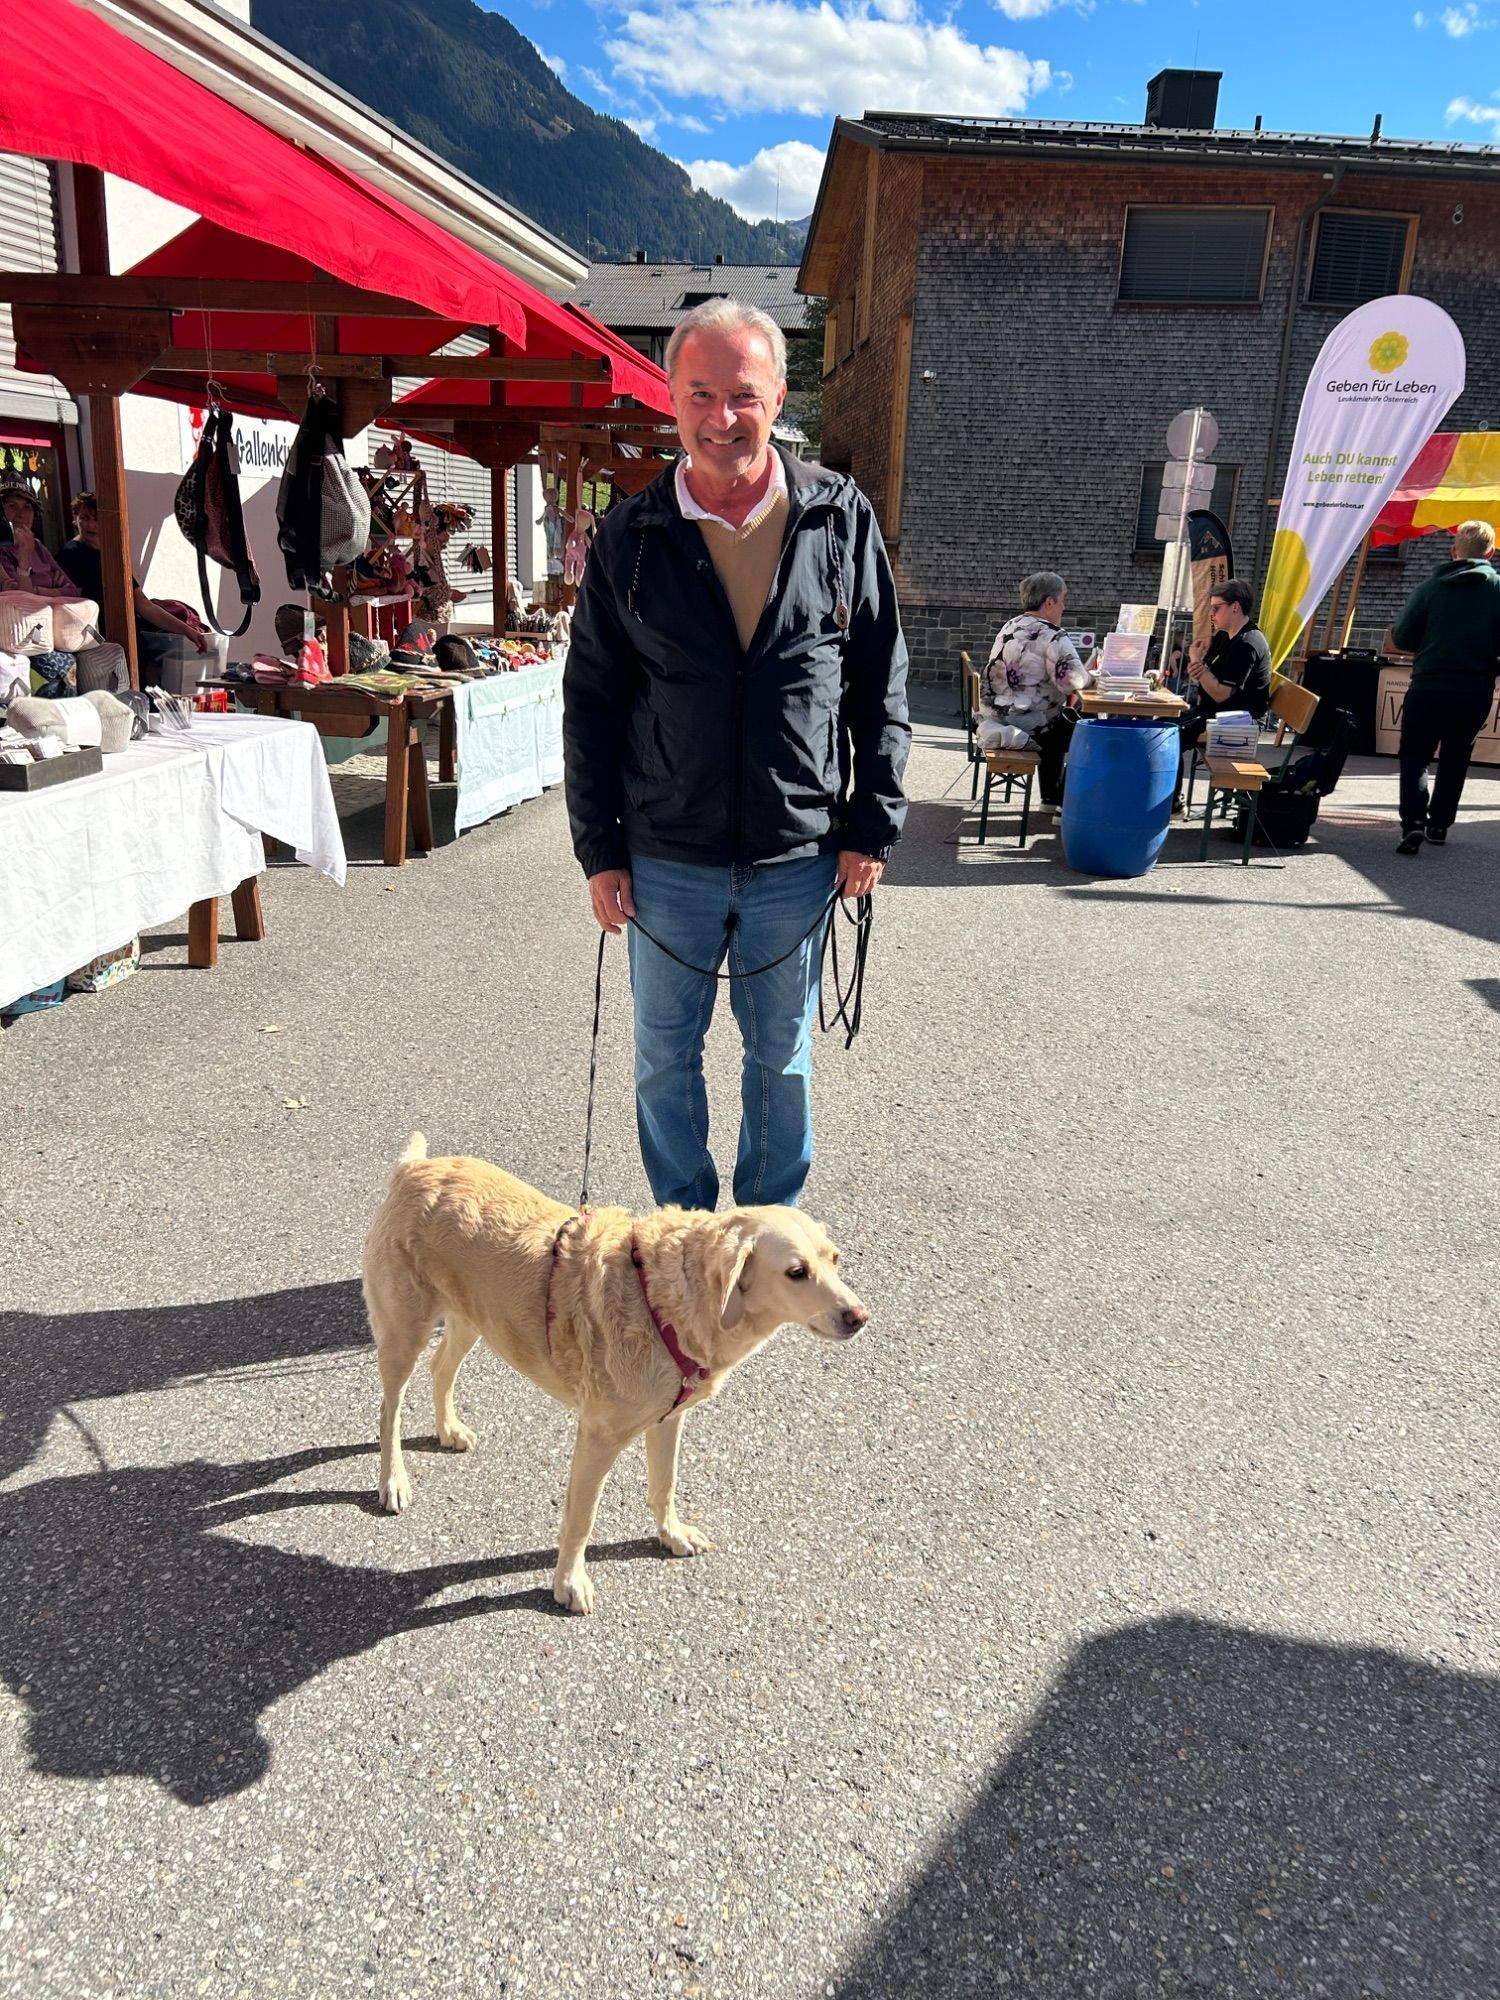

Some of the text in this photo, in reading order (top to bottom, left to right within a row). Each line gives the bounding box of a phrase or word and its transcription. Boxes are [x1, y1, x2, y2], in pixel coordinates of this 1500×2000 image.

[1452, 203, 1464, 225] 8
[1326, 379, 1437, 394] Geben für Leben
[1382, 394, 1418, 404] Österreich
[236, 427, 292, 468] Gallenki
[1303, 453, 1398, 466] Auch DU kannst
[1307, 471, 1386, 484] Leben retten!
